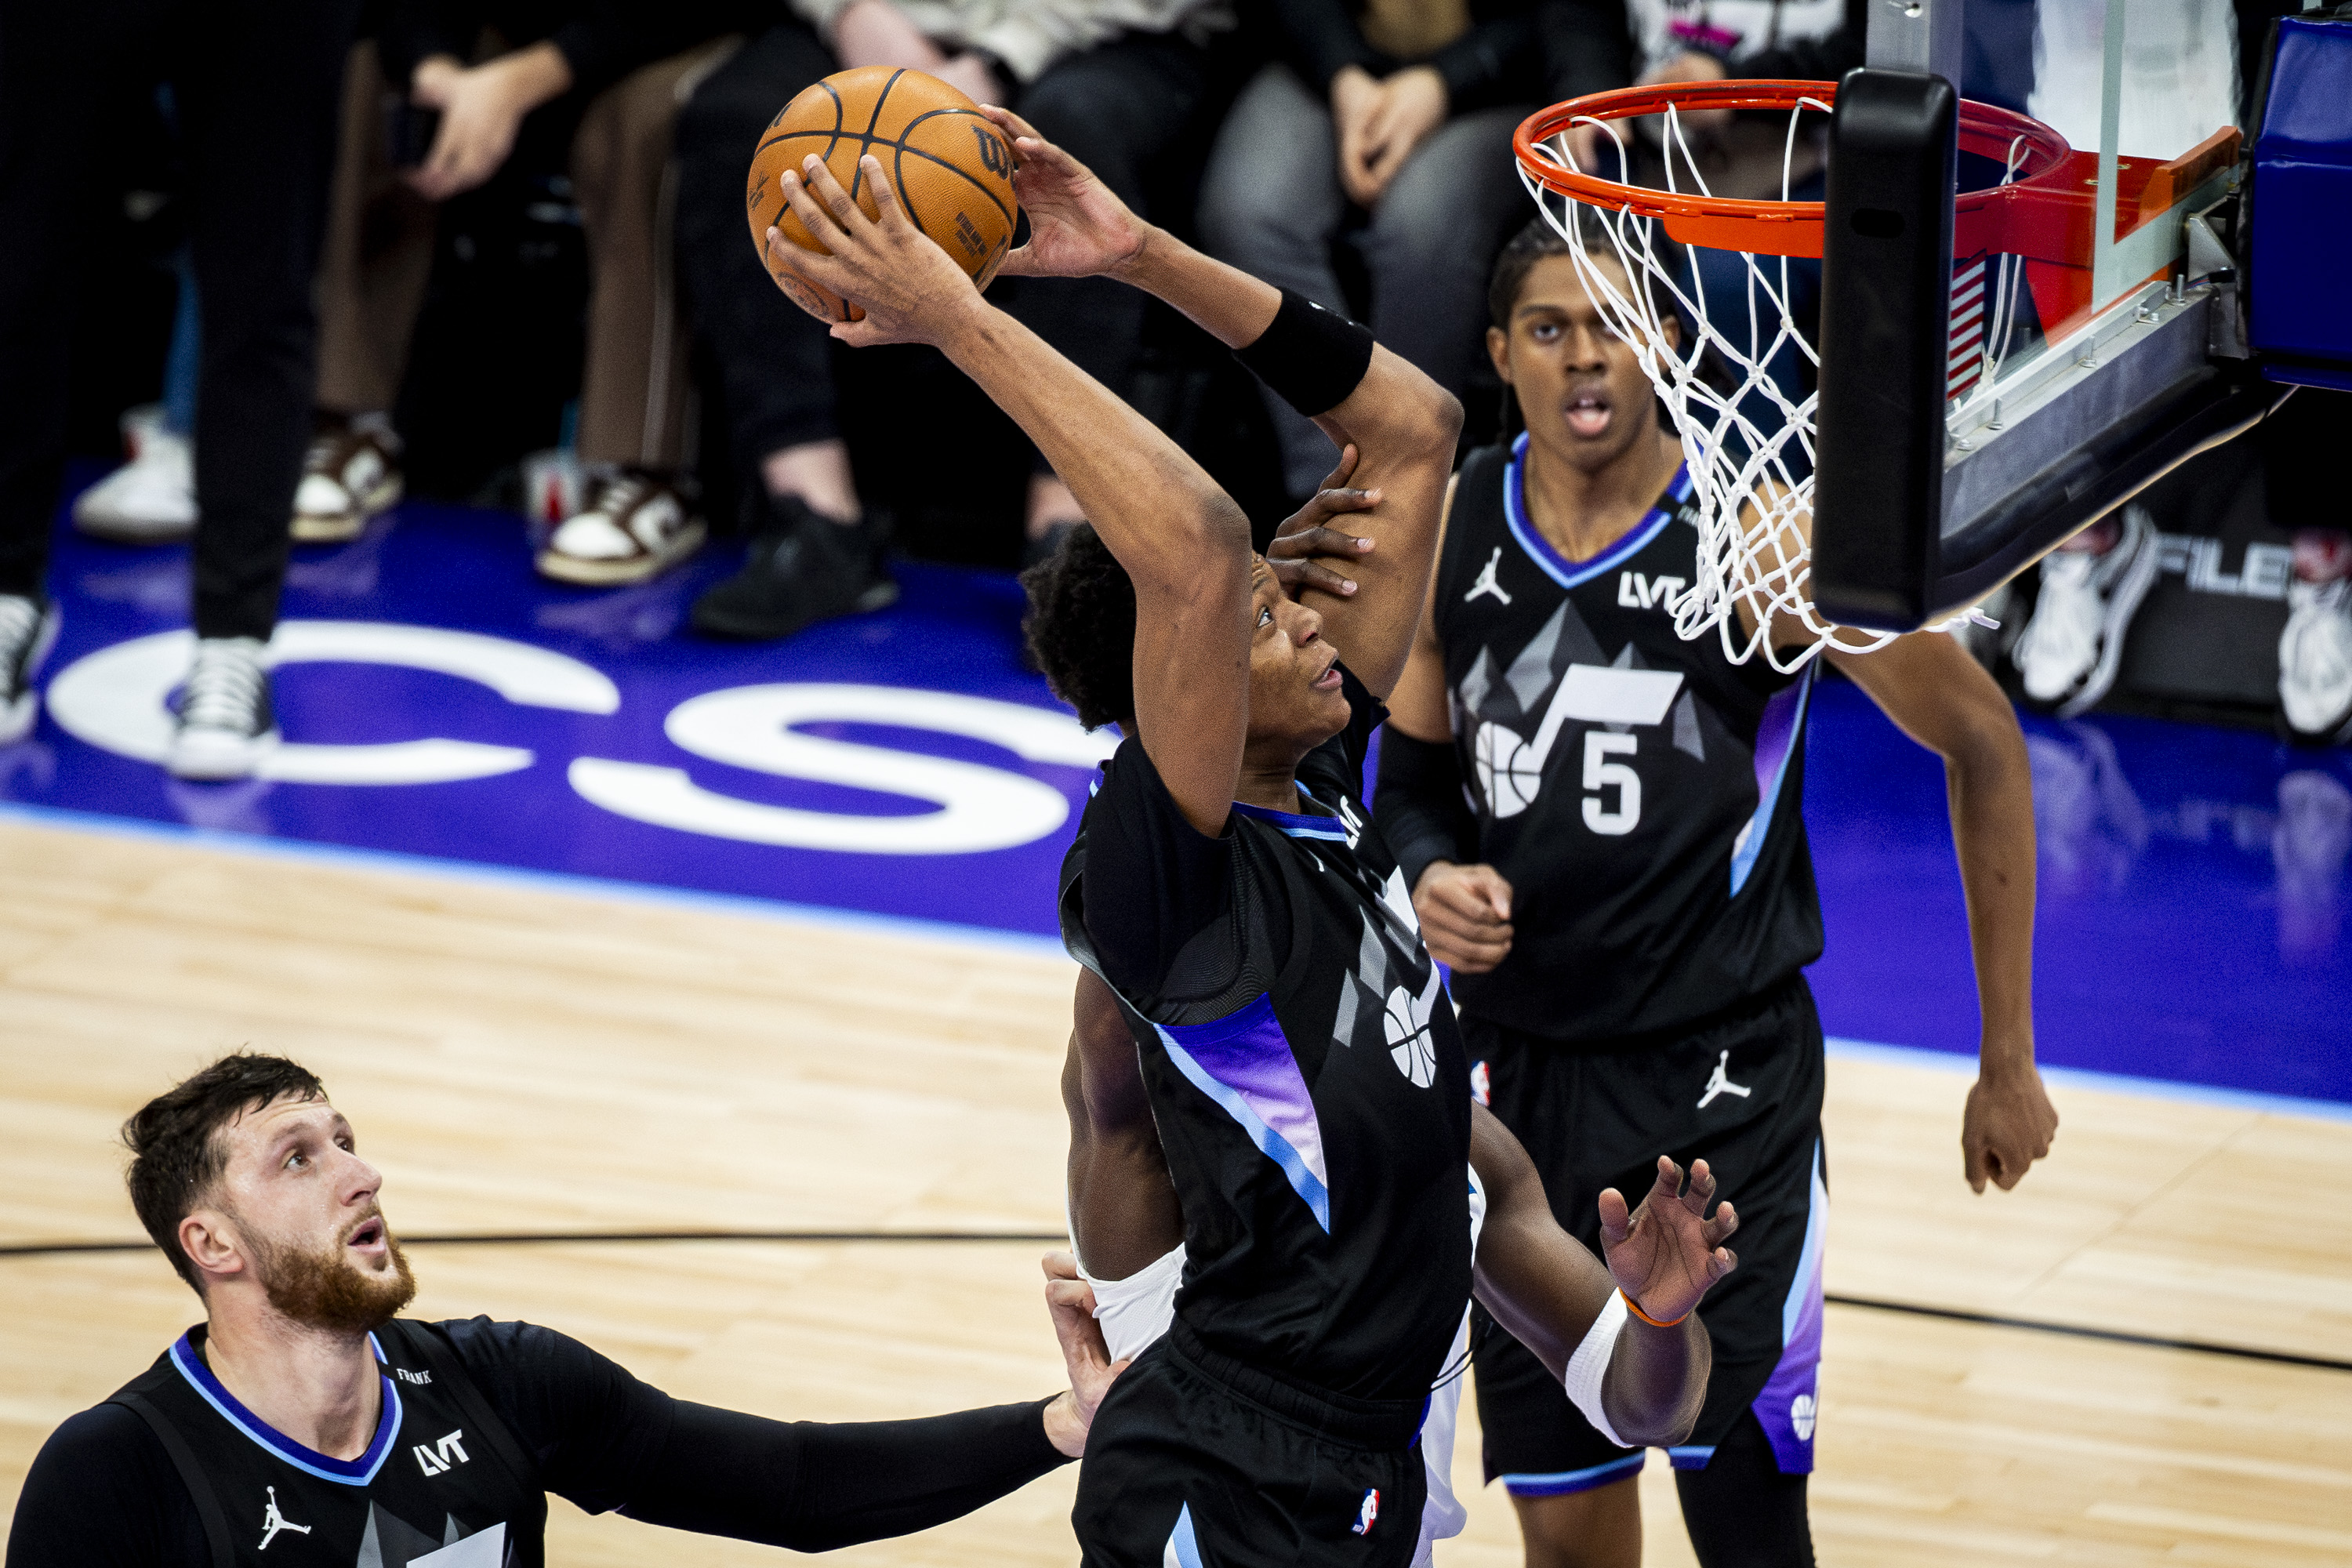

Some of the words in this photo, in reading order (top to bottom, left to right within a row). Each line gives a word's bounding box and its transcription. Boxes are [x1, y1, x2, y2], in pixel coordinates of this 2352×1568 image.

[1618, 572, 1686, 610] LVT
[1581, 731, 1642, 835] 5
[397, 1368, 432, 1385] FRANK
[412, 1429, 470, 1476] LVT
